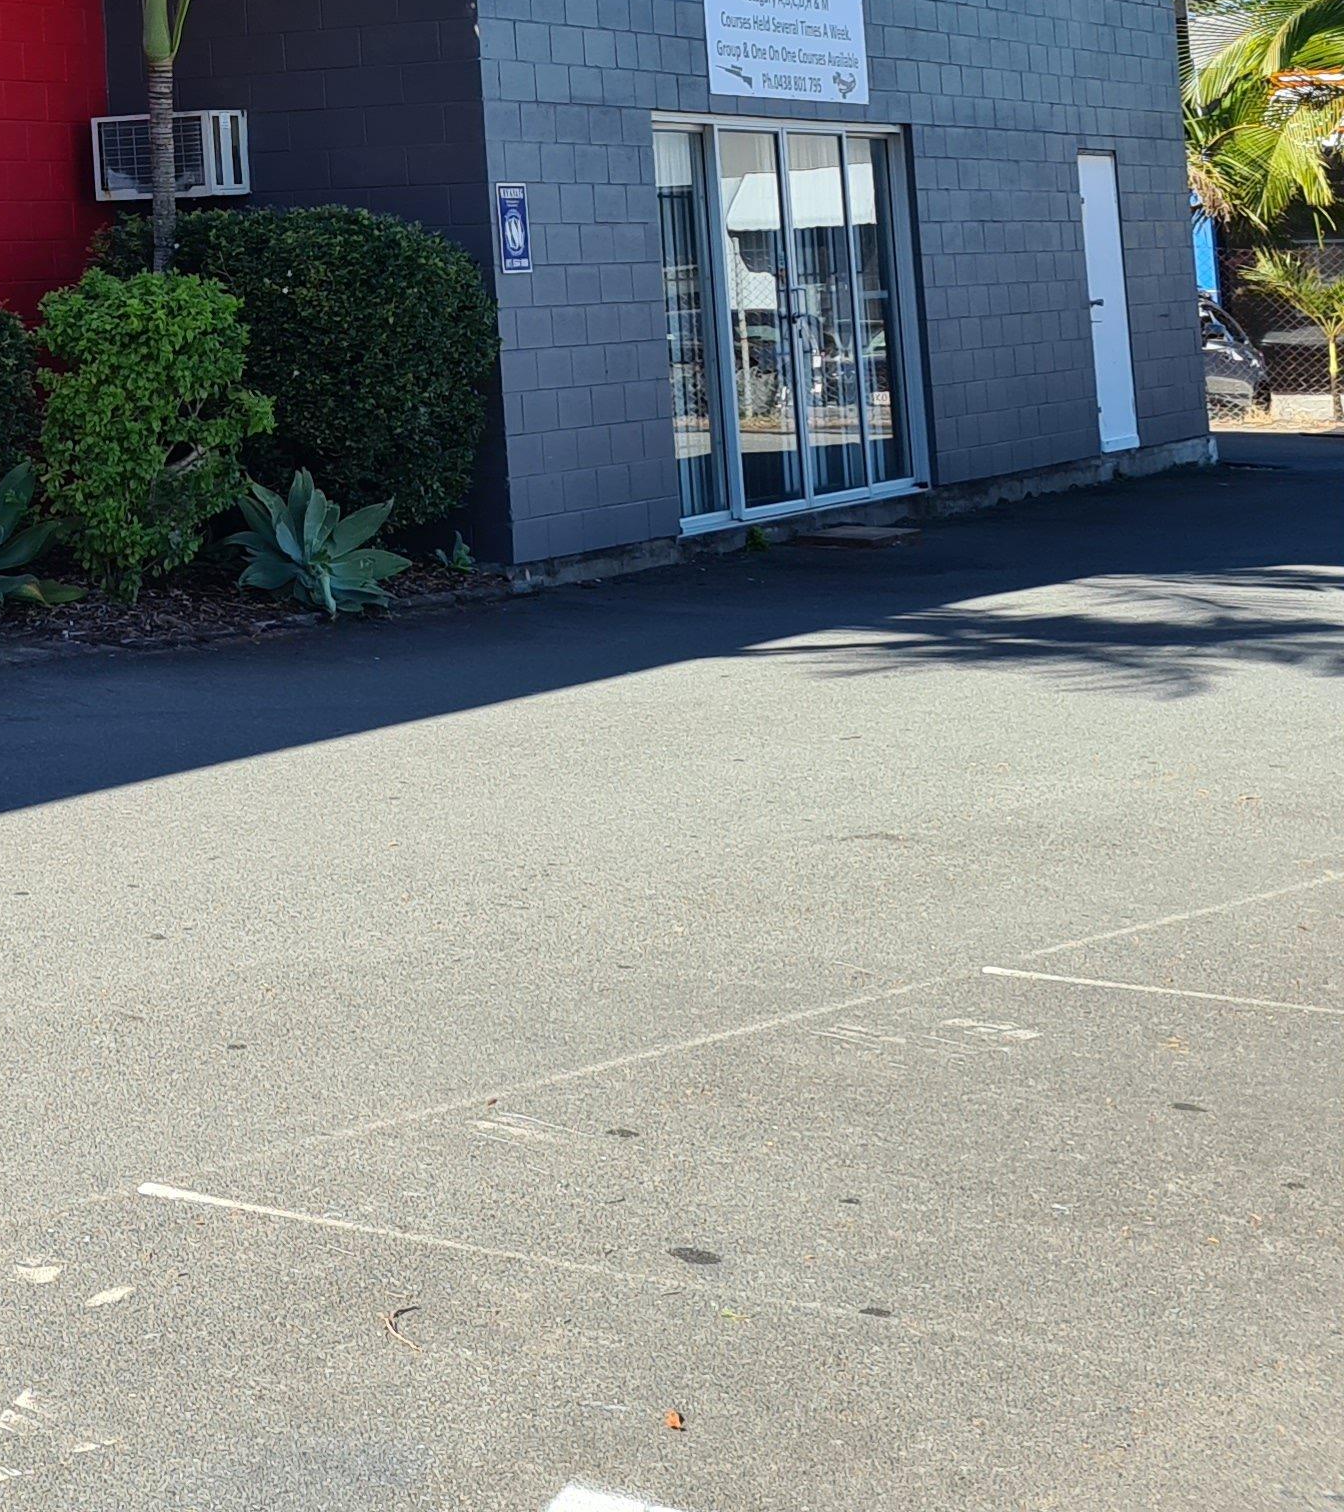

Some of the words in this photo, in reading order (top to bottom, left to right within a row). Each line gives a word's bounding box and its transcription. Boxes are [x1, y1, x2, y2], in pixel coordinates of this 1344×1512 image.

[720, 11, 752, 29] Courses
[753, 14, 771, 31] Held
[772, 17, 798, 35] Several
[800, 21, 822, 37] Times
[823, 24, 829, 38] A
[717, 40, 741, 61] Group
[743, 42, 749, 57] &
[751, 44, 766, 59] One
[769, 45, 779, 60] On
[781, 47, 796, 63] One
[798, 49, 826, 65] Courses
[828, 52, 859, 69] Available
